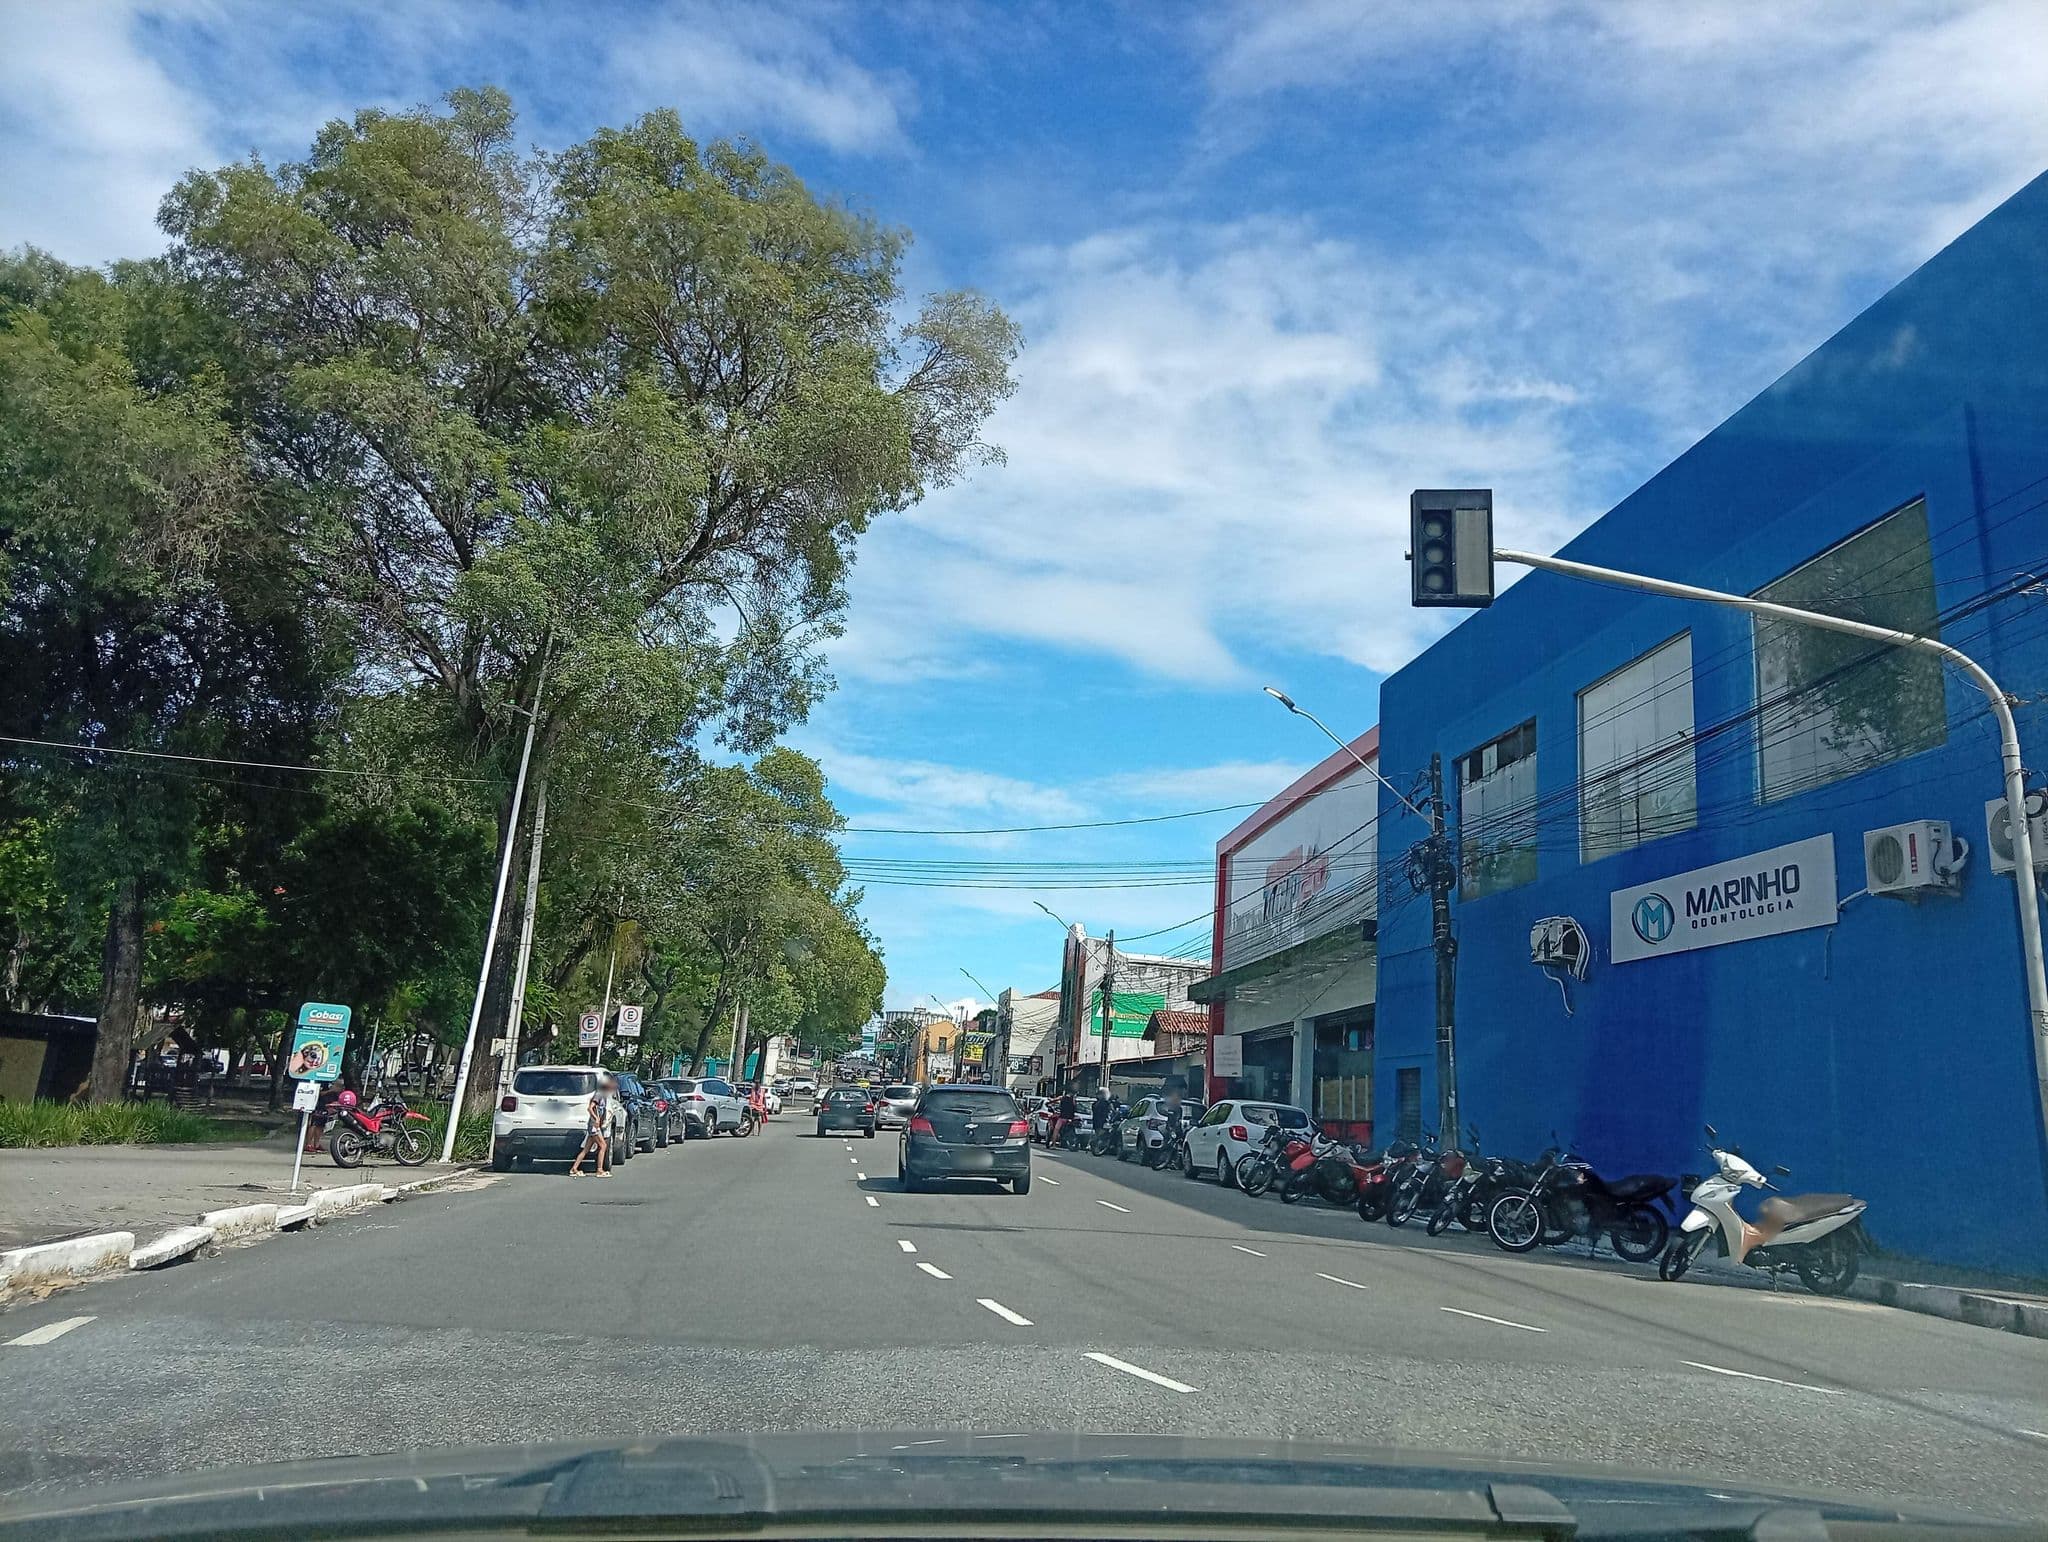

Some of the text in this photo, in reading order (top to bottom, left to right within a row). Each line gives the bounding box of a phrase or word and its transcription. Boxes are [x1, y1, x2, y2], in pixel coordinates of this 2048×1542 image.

[1685, 863, 1800, 918] MARINHO
[1641, 898, 1665, 939] M
[1691, 898, 1794, 930] ODONTOLOGIA
[309, 1009, 344, 1020] Cobasi
[587, 1018, 594, 1029] E
[627, 1011, 634, 1020] E
